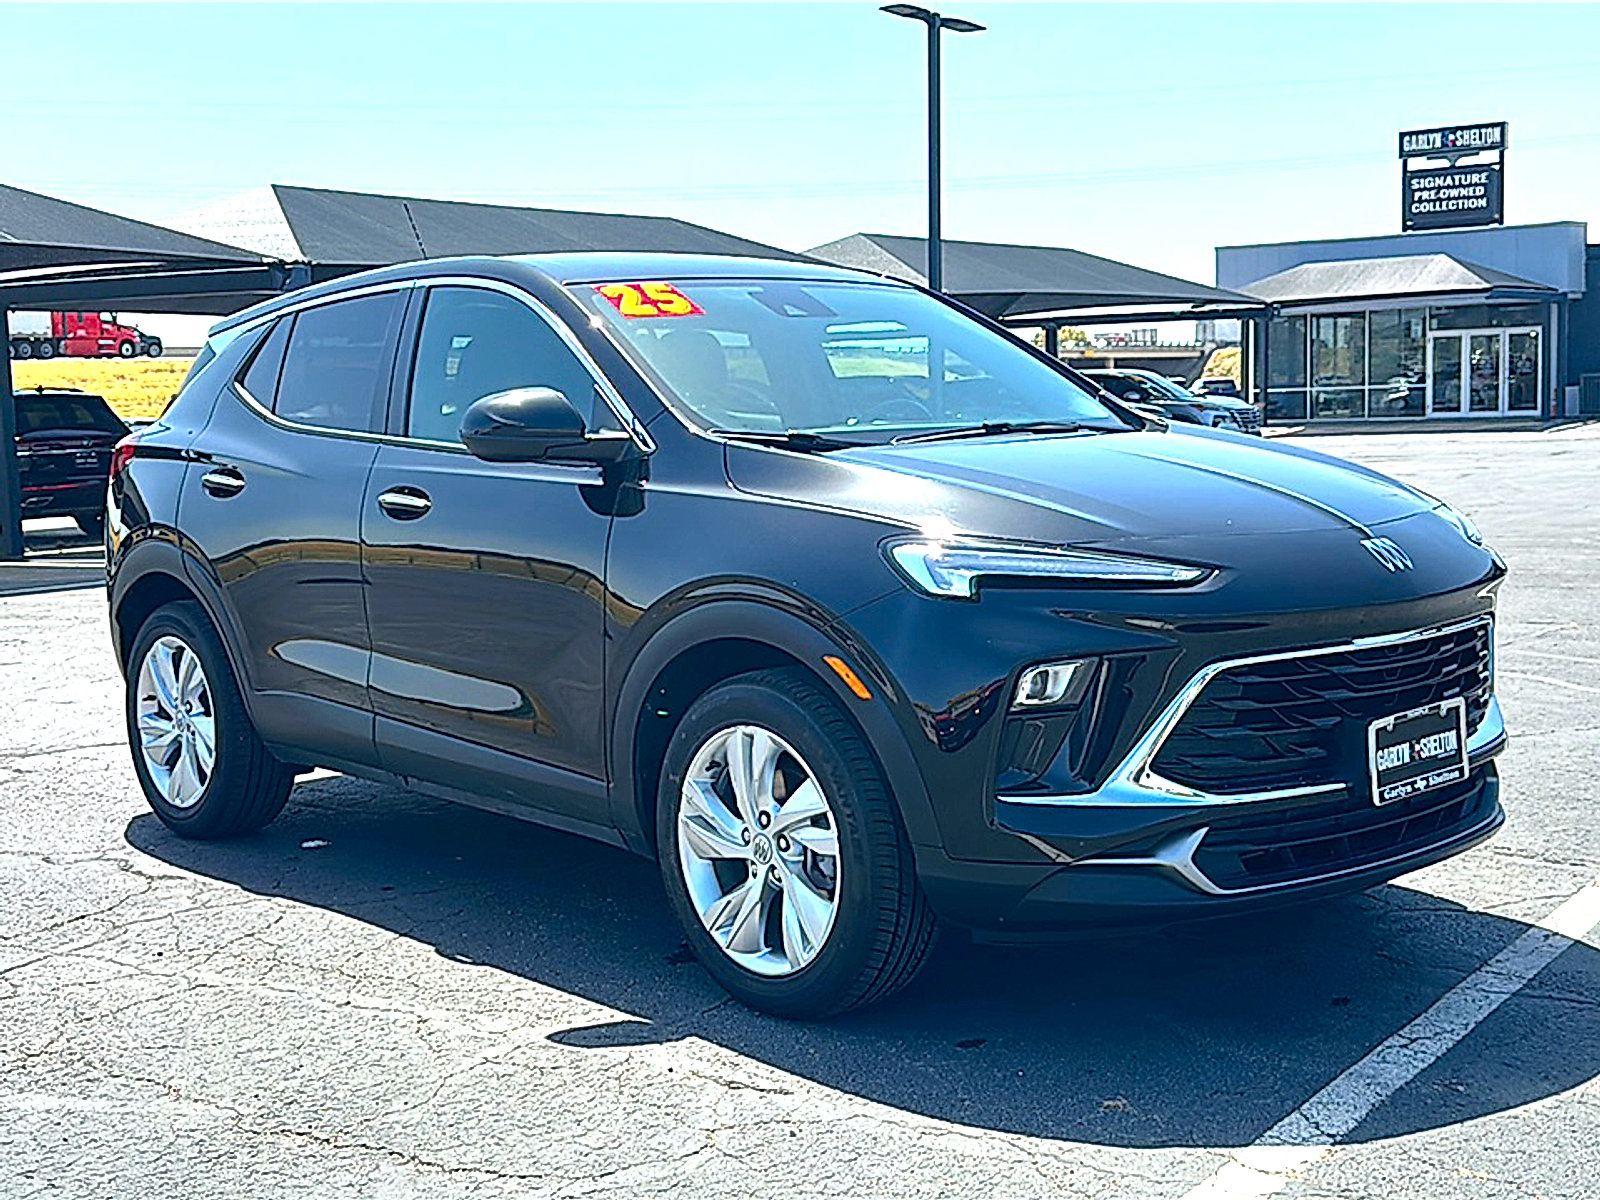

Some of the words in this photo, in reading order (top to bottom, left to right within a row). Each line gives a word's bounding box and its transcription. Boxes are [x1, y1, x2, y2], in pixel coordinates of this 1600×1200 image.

[1403, 132, 1442, 152] GARLYN
[1455, 126, 1501, 147] SHELTON
[1411, 171, 1489, 190] SIGNATURE
[1414, 185, 1485, 202] PRE-OWNED
[1411, 197, 1487, 214] COLLECTION
[600, 283, 692, 315] 25
[1420, 729, 1458, 759] SHELTON
